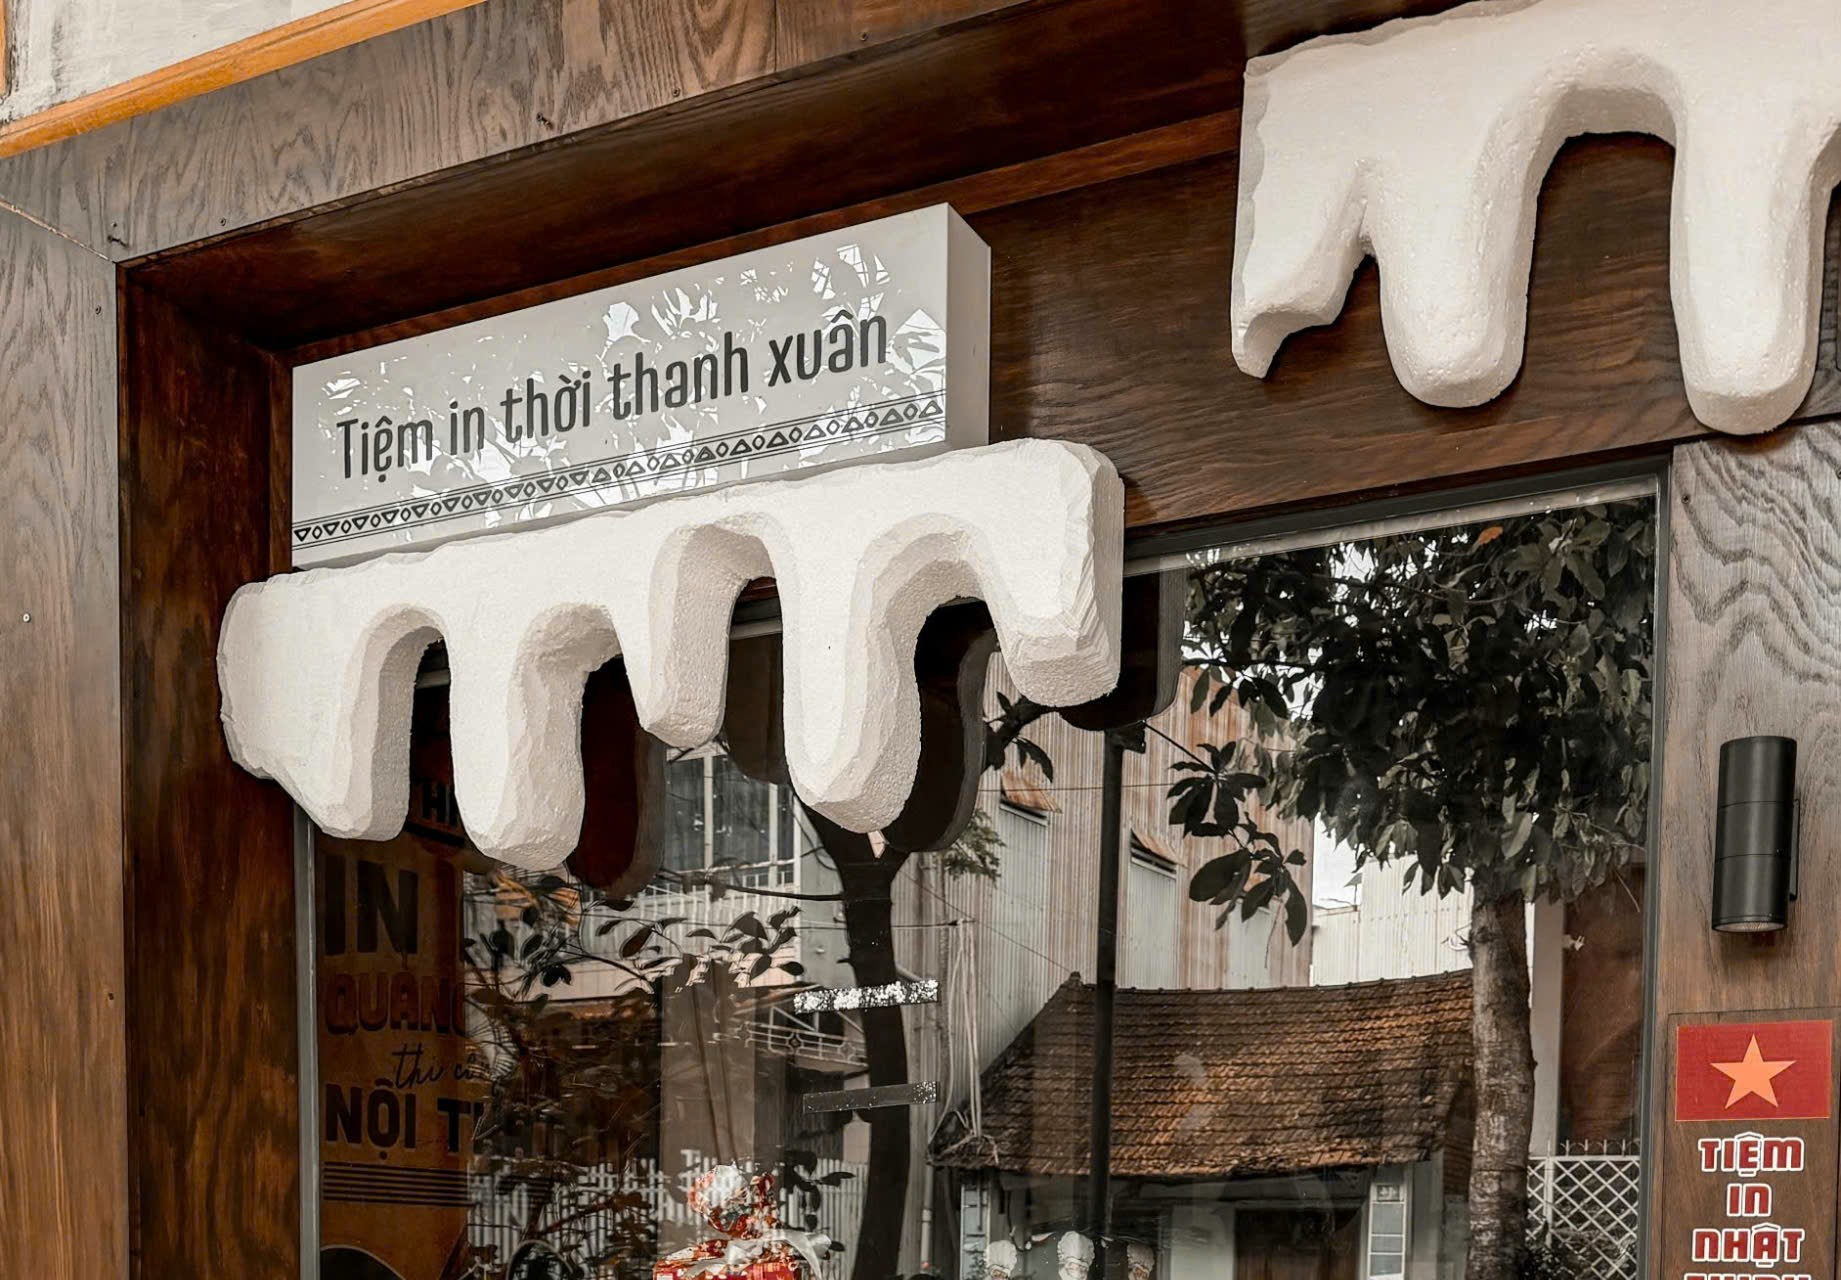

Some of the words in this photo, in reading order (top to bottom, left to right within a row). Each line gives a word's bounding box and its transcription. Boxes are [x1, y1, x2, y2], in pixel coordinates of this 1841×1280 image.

[336, 416, 435, 484] Tiệm
[449, 400, 486, 457] in
[500, 371, 592, 443] thời
[608, 330, 749, 421] thanh
[768, 310, 889, 388] xuân
[324, 856, 418, 956] IN
[325, 1077, 417, 1160] NỘI
[1698, 1132, 1804, 1177] TIỆM
[1727, 1184, 1771, 1217] IN
[1692, 1223, 1804, 1267] NHẬT
